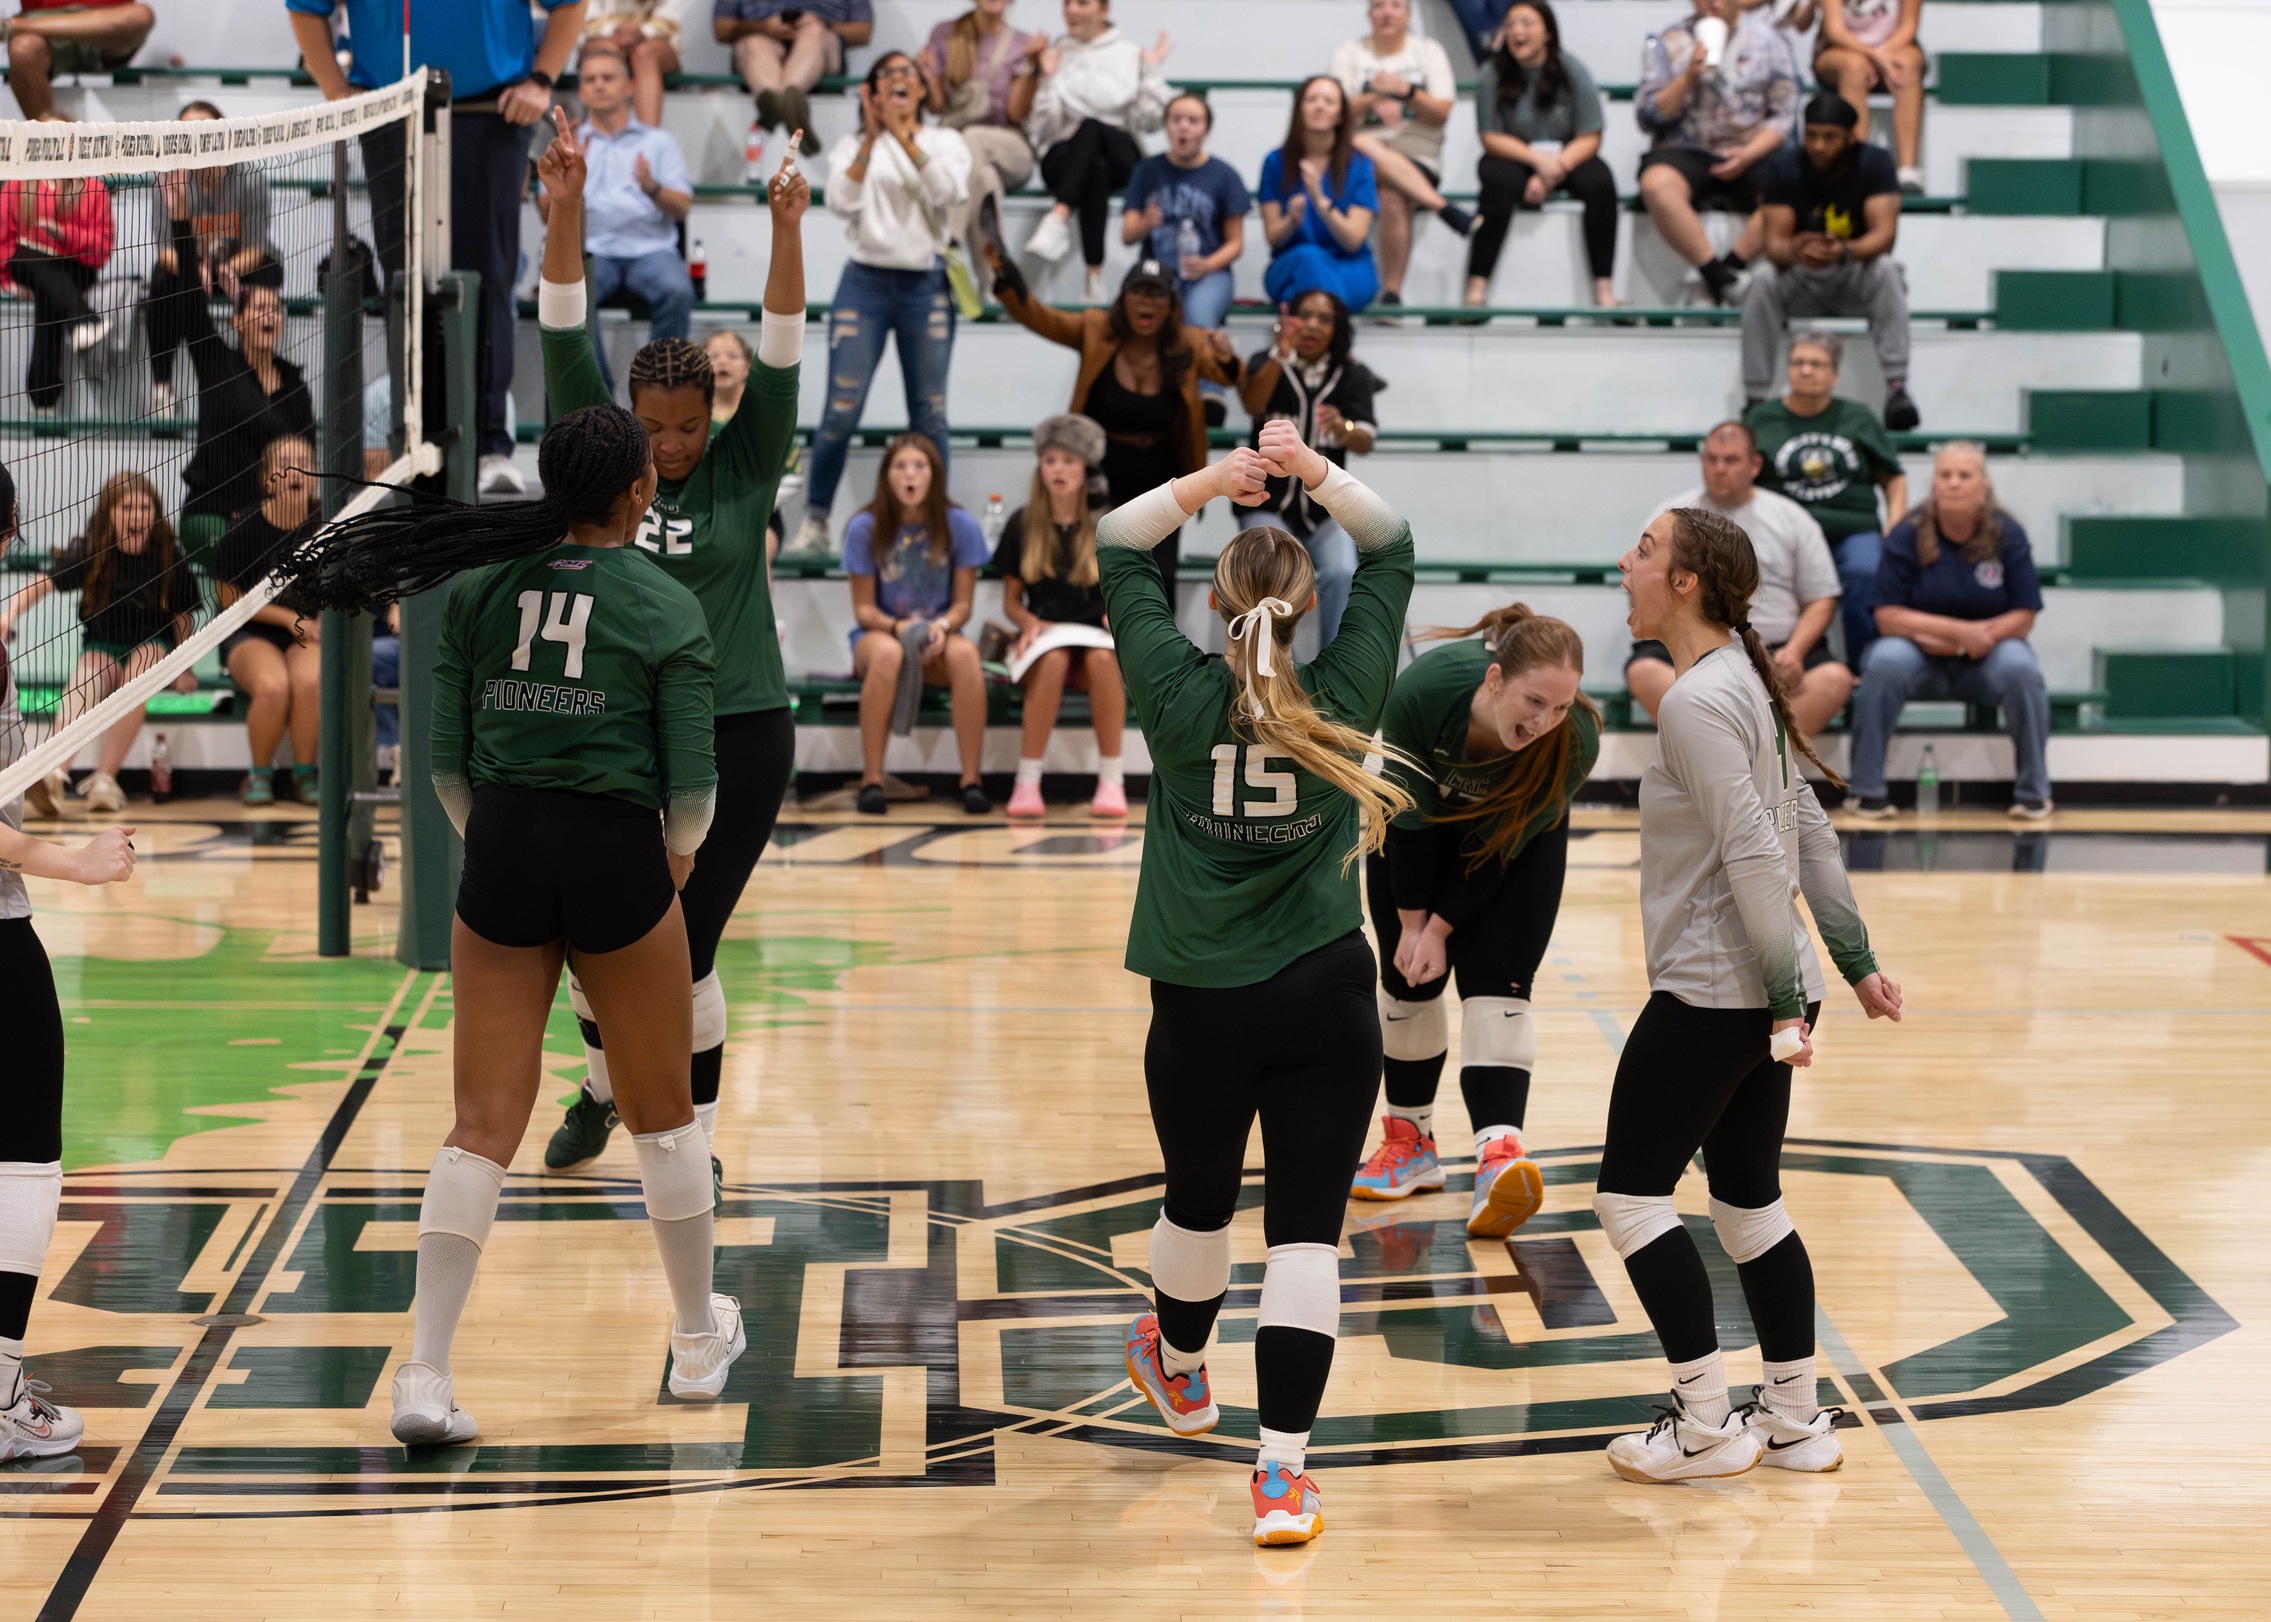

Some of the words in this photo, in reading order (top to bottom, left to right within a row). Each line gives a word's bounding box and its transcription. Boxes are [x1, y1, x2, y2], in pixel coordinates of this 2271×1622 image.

[511, 590, 594, 679] 14
[482, 680, 605, 714] PIONEERS
[1211, 744, 1298, 817] 15
